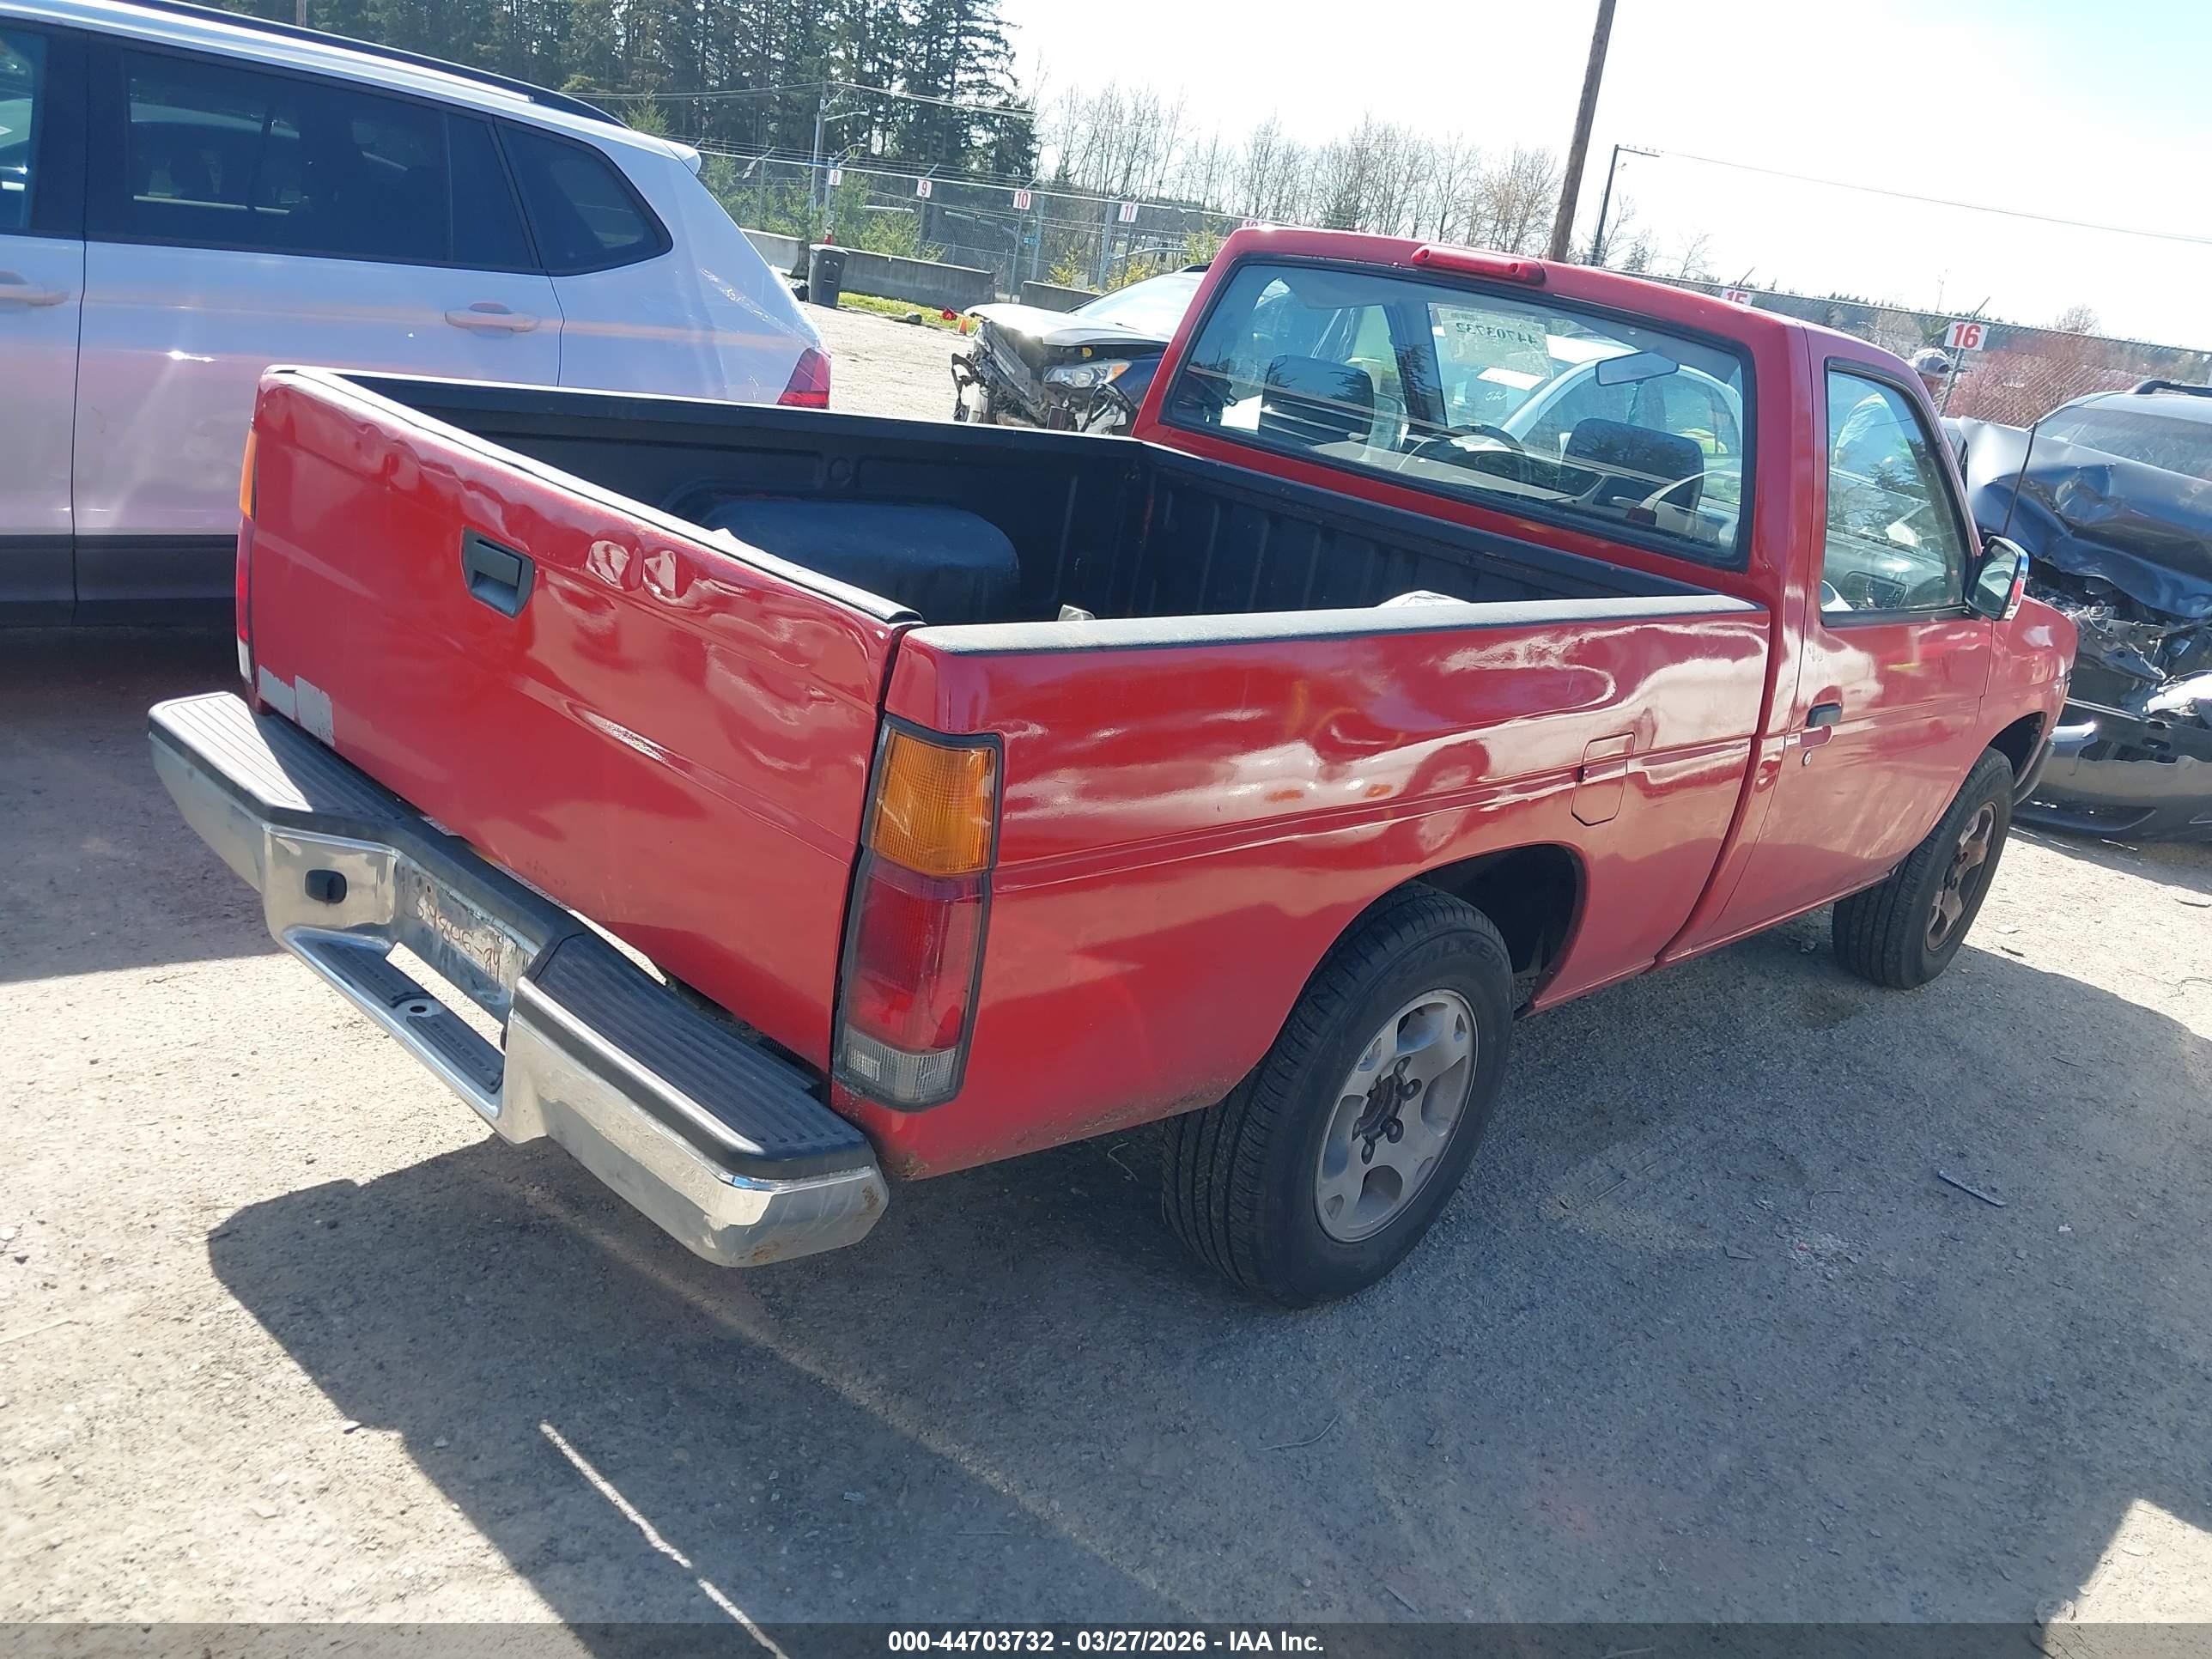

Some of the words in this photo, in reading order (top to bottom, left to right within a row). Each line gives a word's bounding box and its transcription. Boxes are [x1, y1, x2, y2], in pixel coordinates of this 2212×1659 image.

[832, 171, 838, 184] 8
[921, 181, 927, 196] 9
[1018, 193, 1029, 208] 10
[1124, 205, 1134, 221] 11
[1954, 324, 1981, 349] 16
